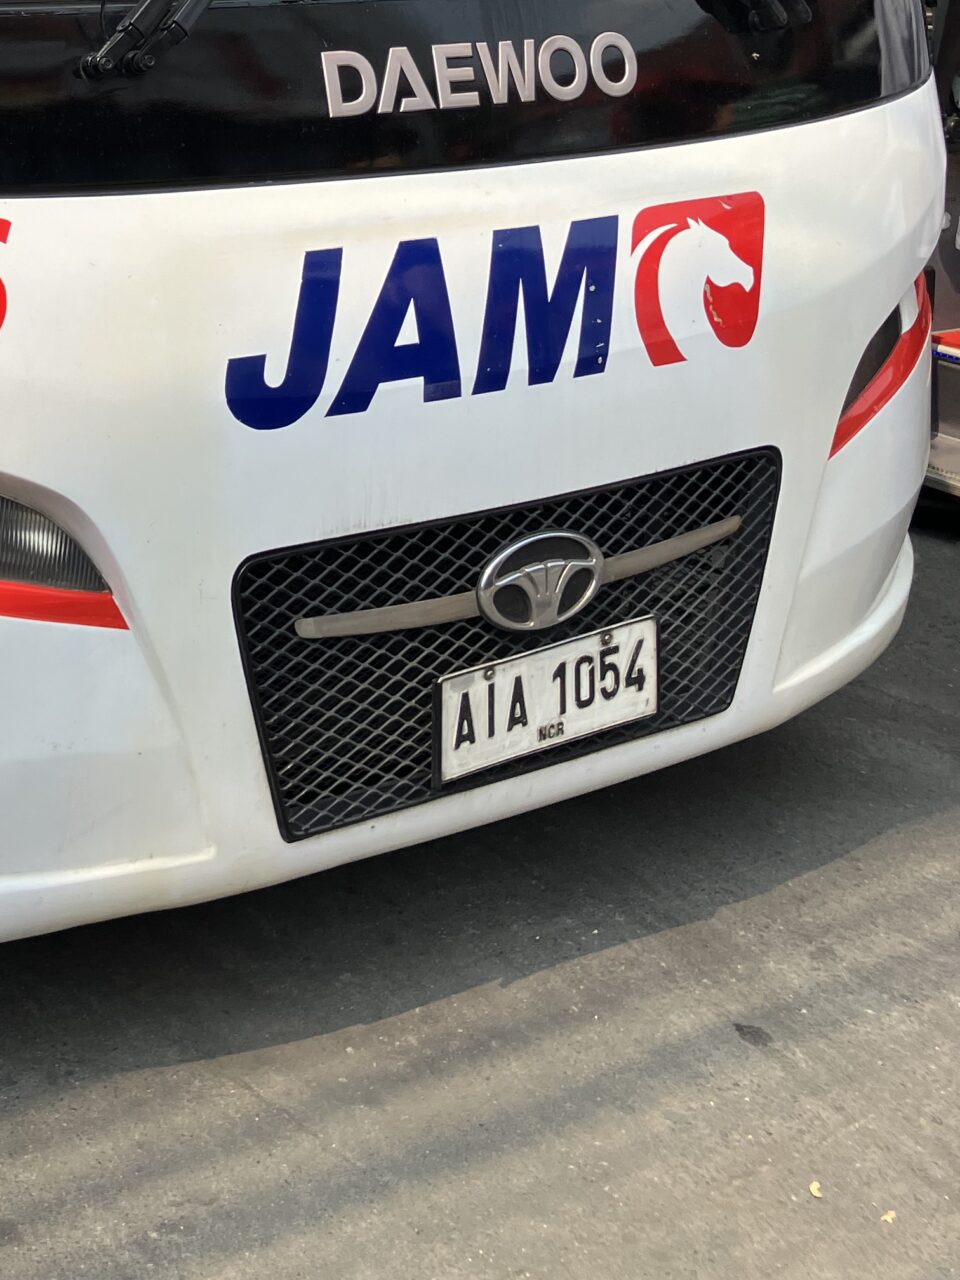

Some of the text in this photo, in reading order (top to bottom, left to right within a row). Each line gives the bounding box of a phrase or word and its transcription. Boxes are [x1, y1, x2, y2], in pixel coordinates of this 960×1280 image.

[321, 31, 639, 119] DAEWOO
[225, 214, 620, 431] JAM
[453, 639, 646, 751] AIA 1054
[537, 722, 565, 741] NCR
